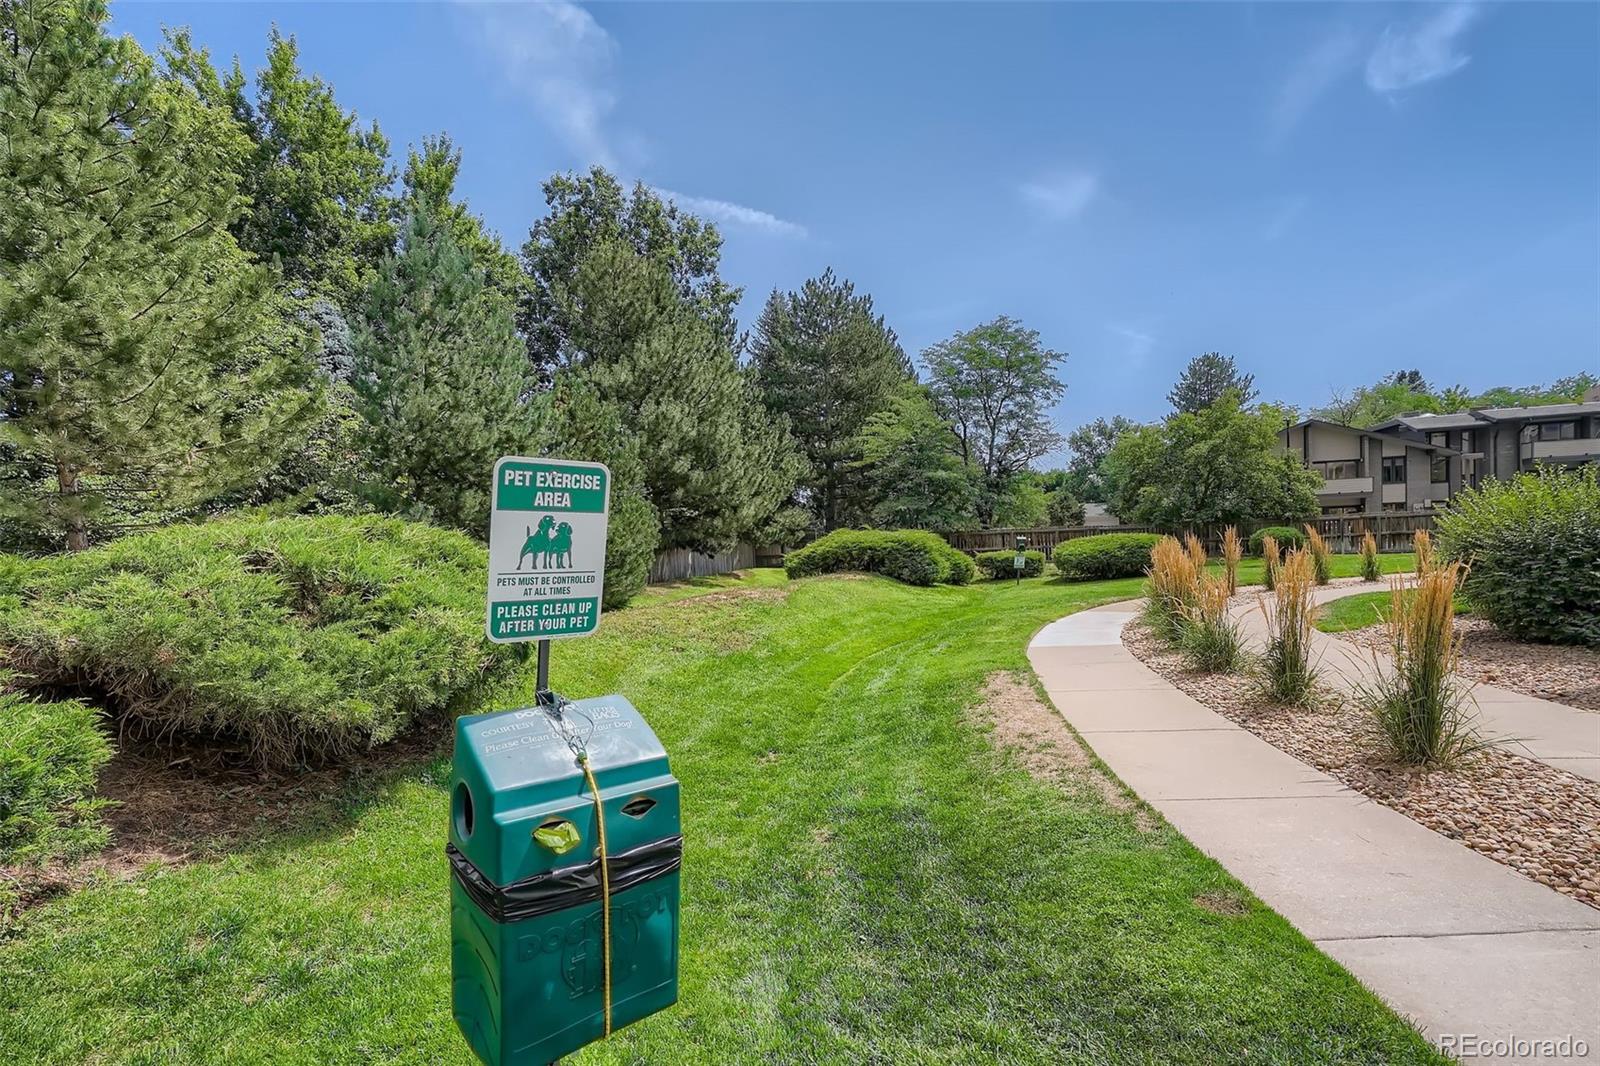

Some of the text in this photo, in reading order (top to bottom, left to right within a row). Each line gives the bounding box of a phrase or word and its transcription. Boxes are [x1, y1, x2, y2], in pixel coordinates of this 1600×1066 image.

[504, 469, 601, 490] PET EXERCISE
[534, 491, 571, 508] AREA
[496, 575, 596, 587] PETS MUST BE CONTROLLED
[523, 586, 571, 597] AT ALL TIMES
[497, 602, 592, 618] PLEASE CLEAN UP
[499, 616, 590, 634] AFTER YOUR PET
[480, 720, 534, 738] COURTESY
[485, 740, 520, 753] Please
[520, 734, 550, 744] Clean
